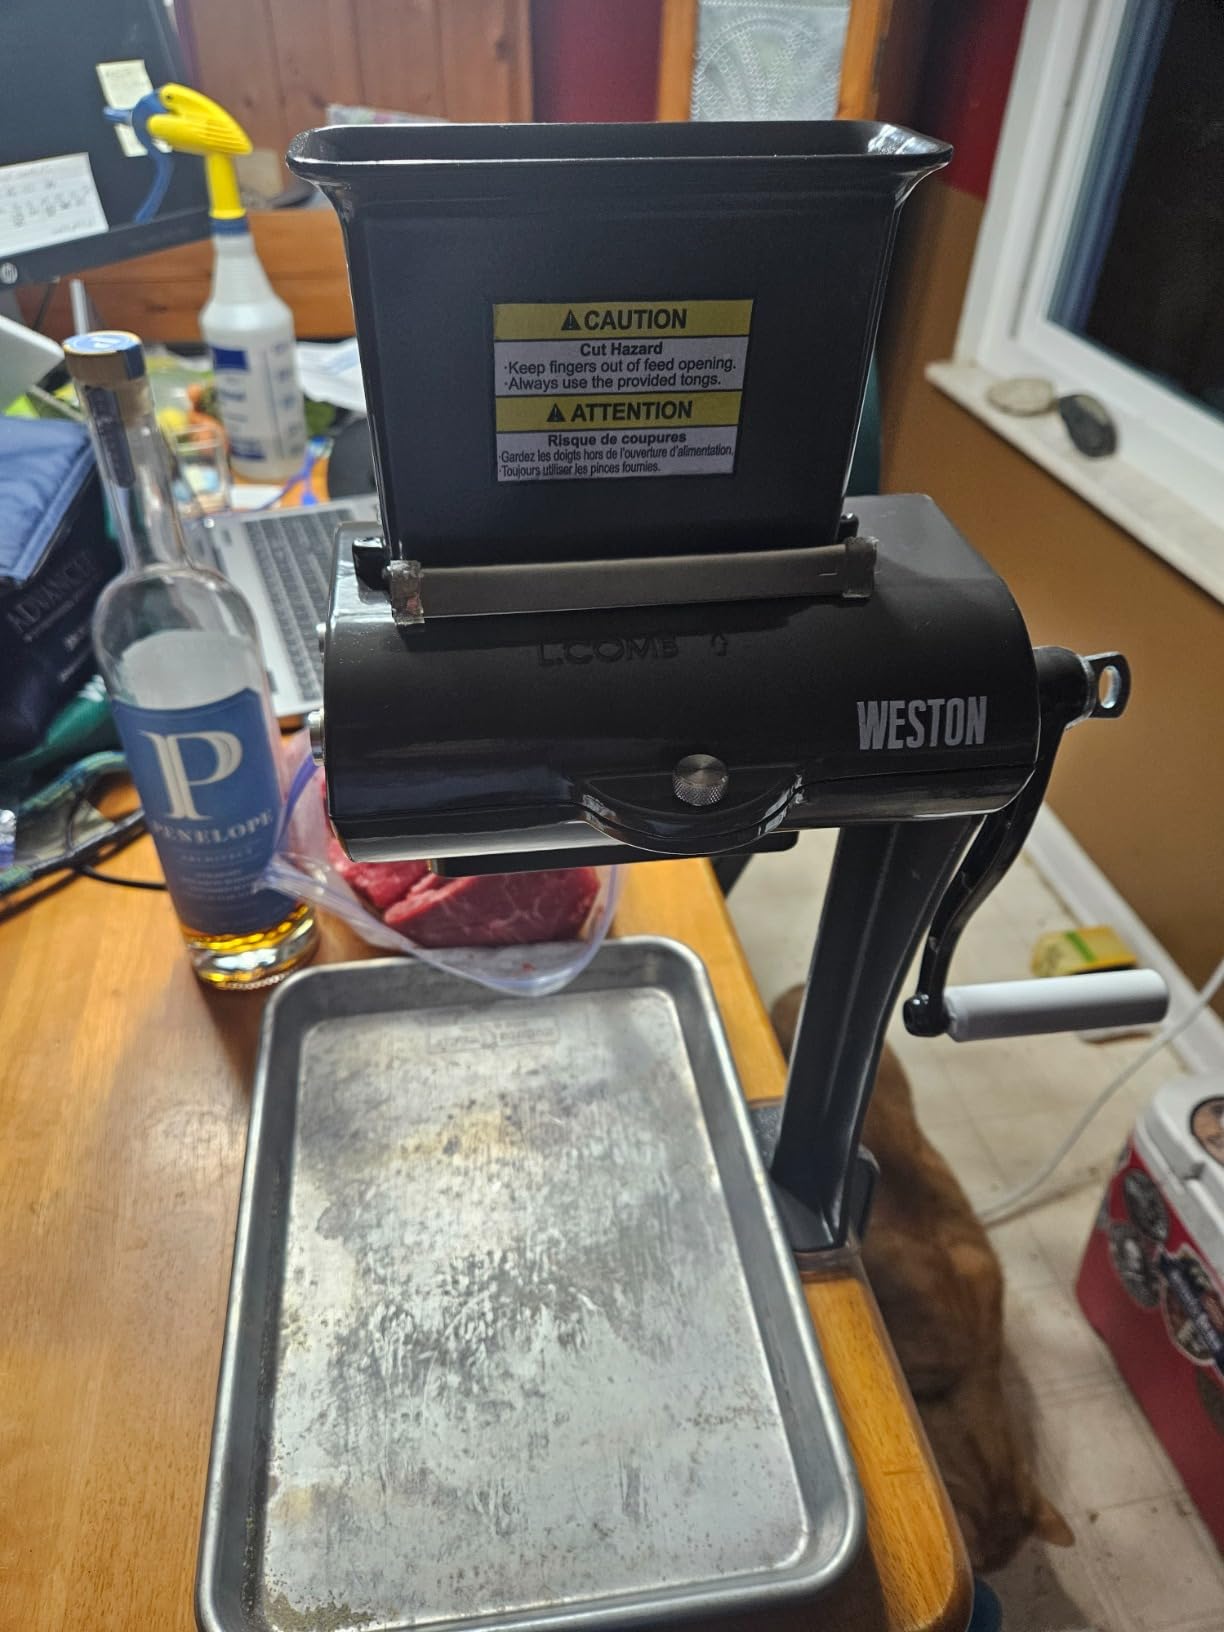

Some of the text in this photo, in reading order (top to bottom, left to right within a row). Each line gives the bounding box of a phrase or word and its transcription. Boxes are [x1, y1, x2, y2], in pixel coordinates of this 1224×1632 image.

[584, 309, 688, 331] CAUTION
[580, 341, 663, 357] Cut Hazard
[508, 355, 737, 377] Keep fingers out of feed opening.
[508, 372, 721, 393] Always use the provided tongs.
[570, 400, 693, 422] ATTENTION
[548, 432, 687, 449] Risque de coupures
[501, 451, 536, 464] Gardez
[538, 449, 552, 462] les
[554, 448, 582, 465] doigts
[584, 448, 604, 461] hors
[606, 447, 618, 460] de
[619, 445, 668, 460] l'ouverture
[502, 464, 541, 479] Toujours
[542, 464, 574, 477] utiliser
[574, 463, 588, 477] les
[590, 462, 620, 476] pinces
[856, 695, 987, 751] WESTON
[136, 730, 244, 821] P
